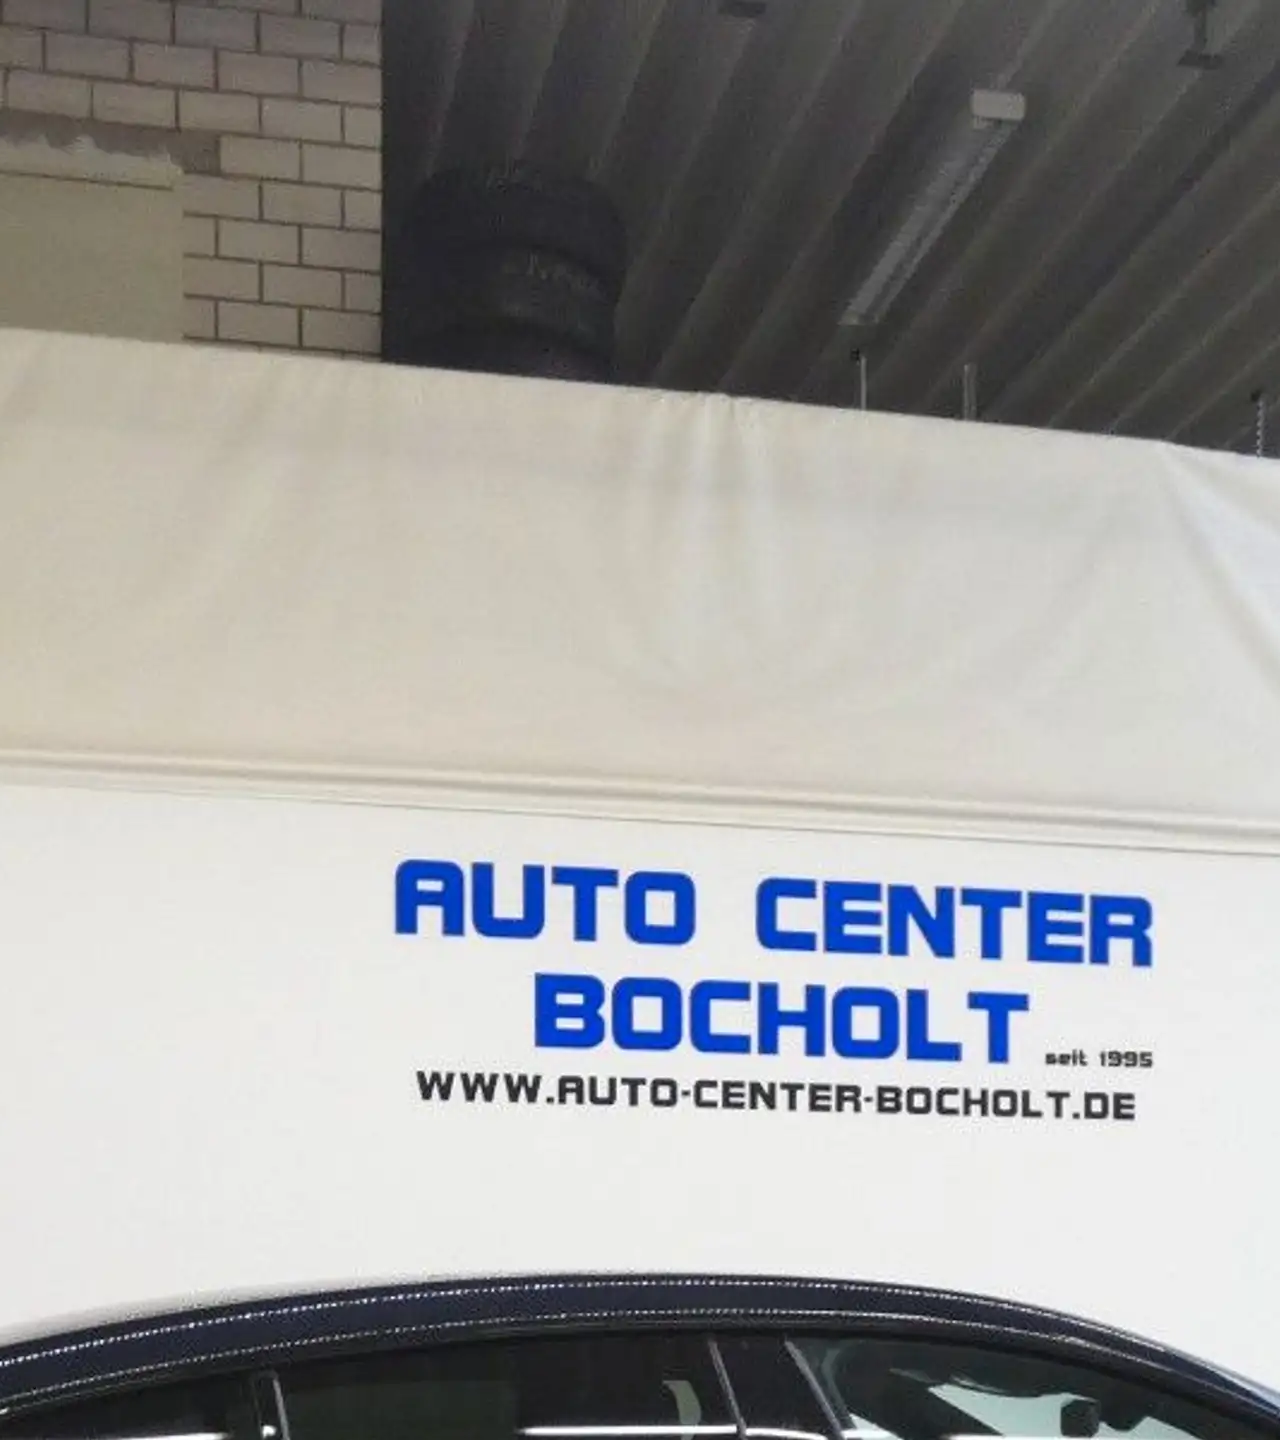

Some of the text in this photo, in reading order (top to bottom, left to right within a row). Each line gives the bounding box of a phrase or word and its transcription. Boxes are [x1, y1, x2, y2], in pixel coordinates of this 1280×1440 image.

[394, 858, 1153, 967] AUTO CENTER
[534, 973, 1153, 1068] BOCHOLT seit 1995
[416, 1070, 1135, 1121] WWW.AUTO-CENTER-BOCHOLT.DE
